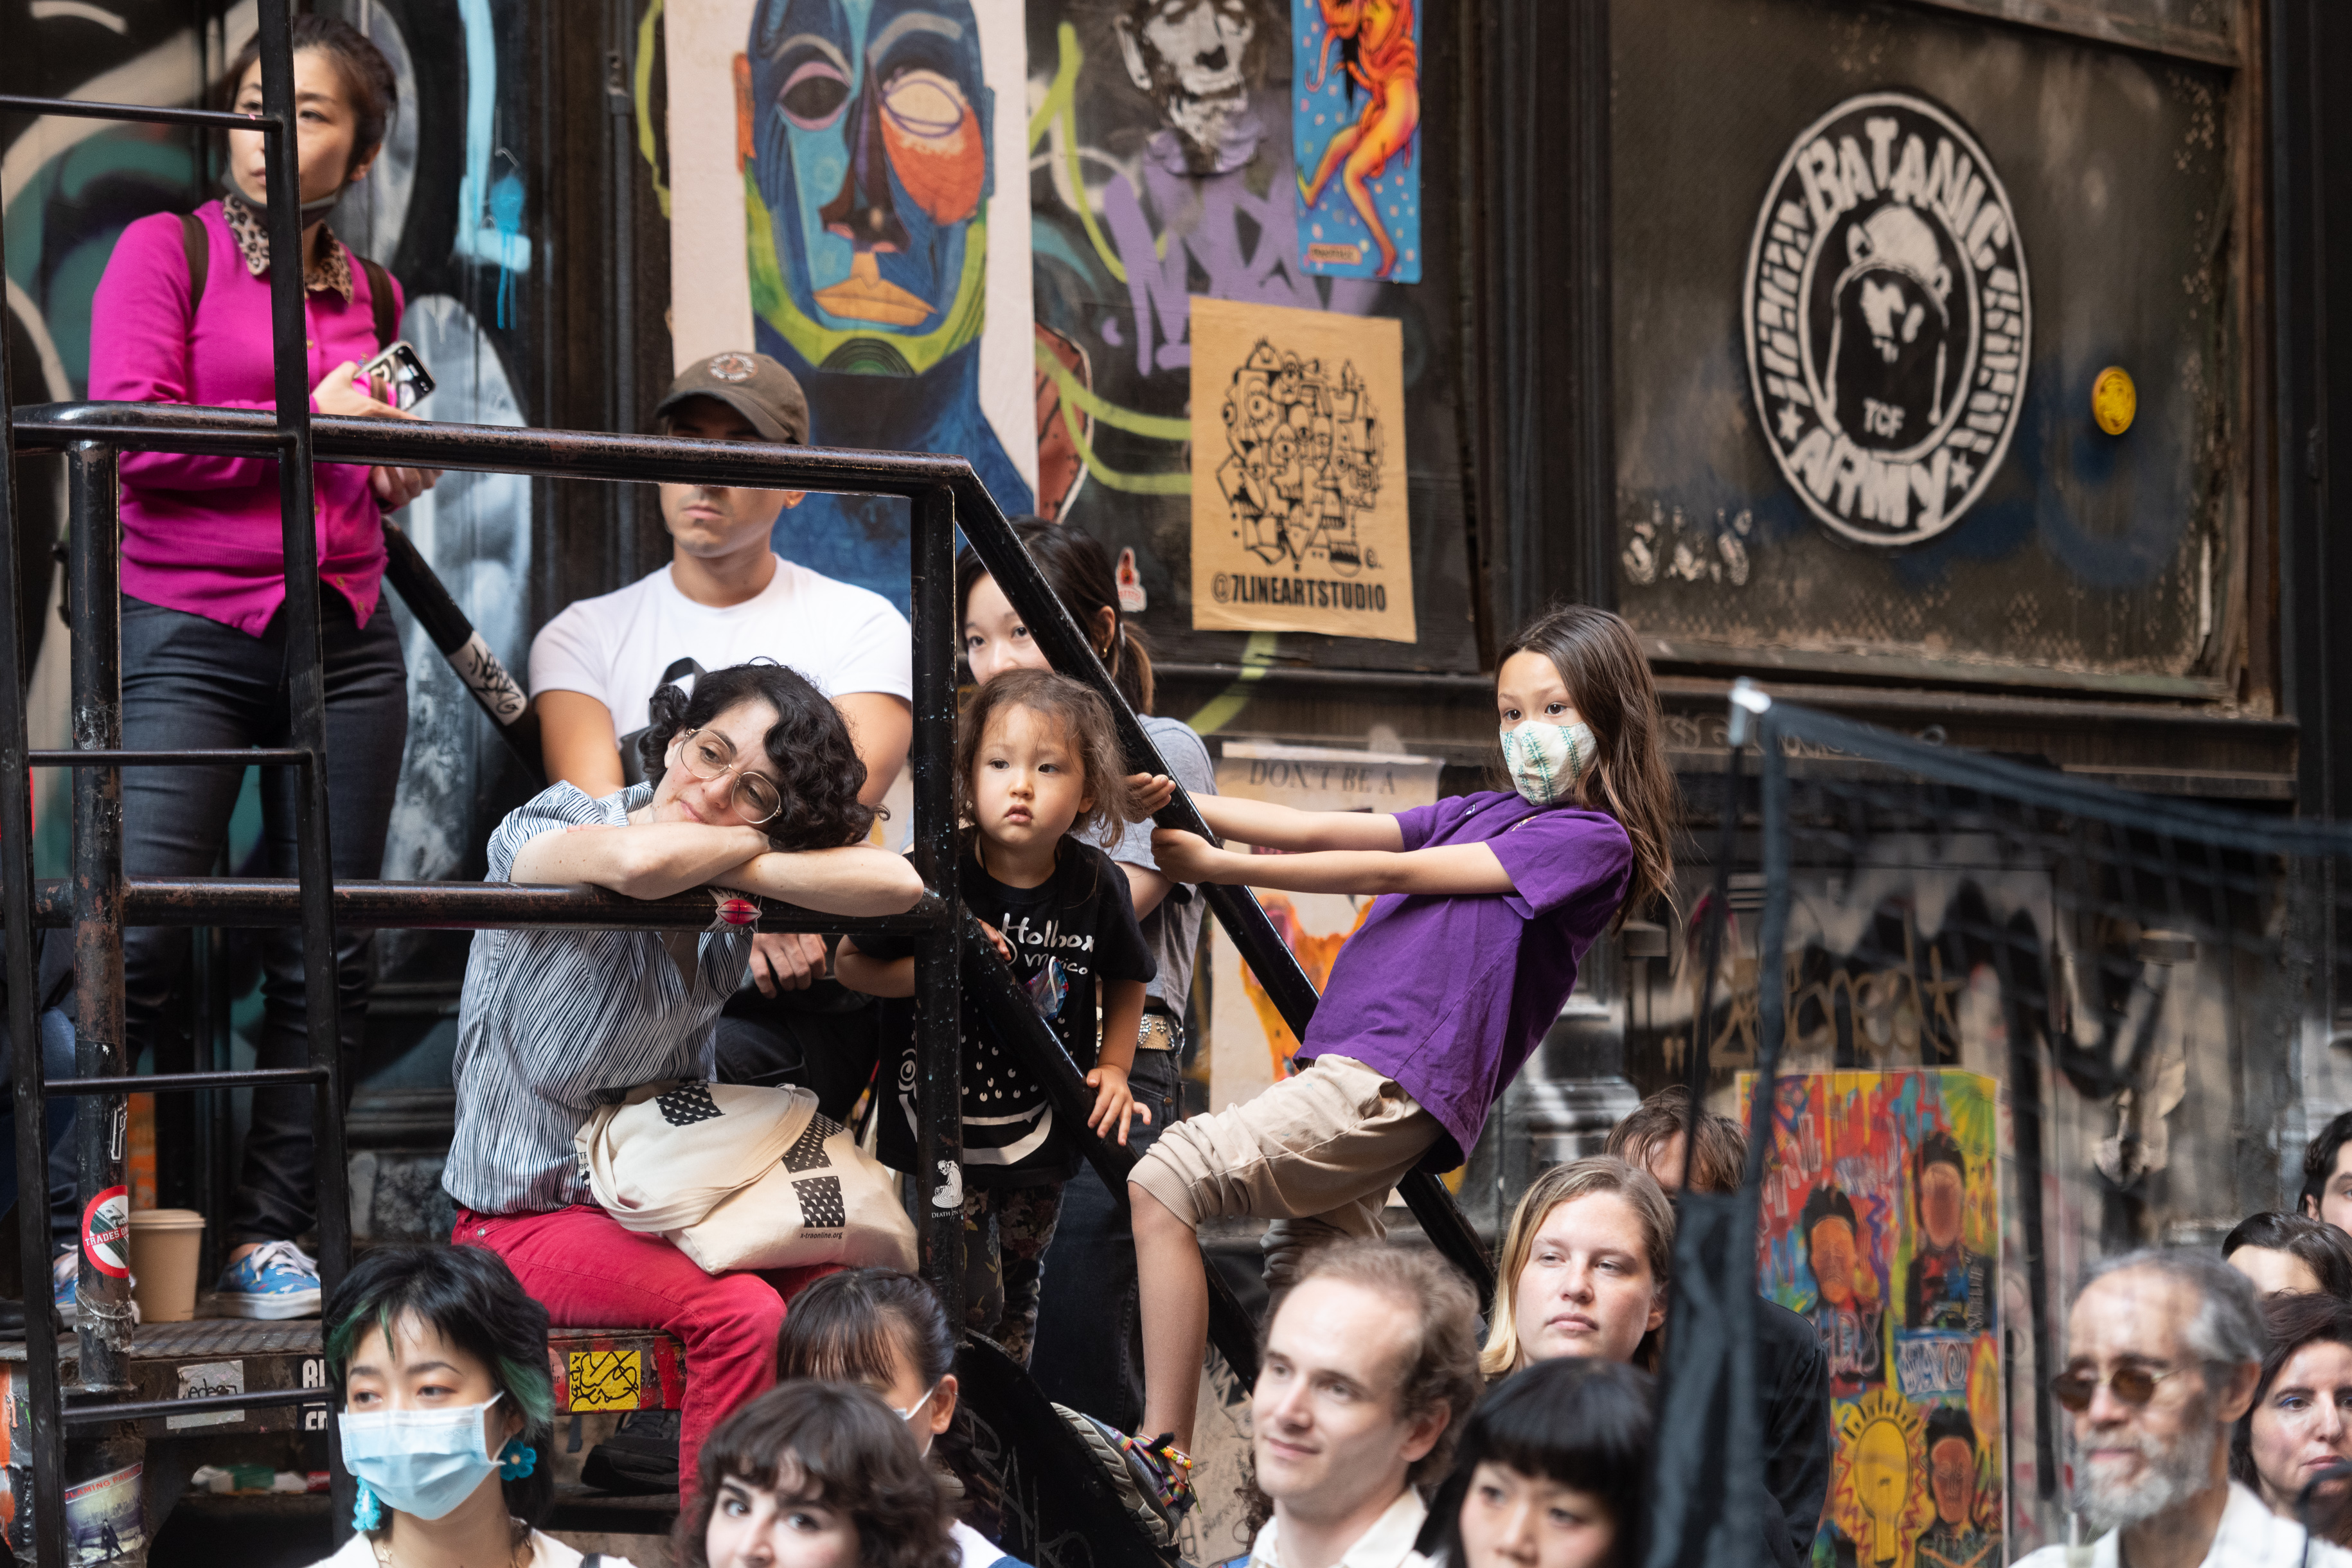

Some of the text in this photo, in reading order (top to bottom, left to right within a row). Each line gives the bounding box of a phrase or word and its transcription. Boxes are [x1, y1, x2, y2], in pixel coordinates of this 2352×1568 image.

[1379, 766, 1395, 794] A
[998, 913, 1094, 964] Holbox
[85, 1230, 120, 1247] TRADES
[799, 1231, 843, 1240] x-traonline.org
